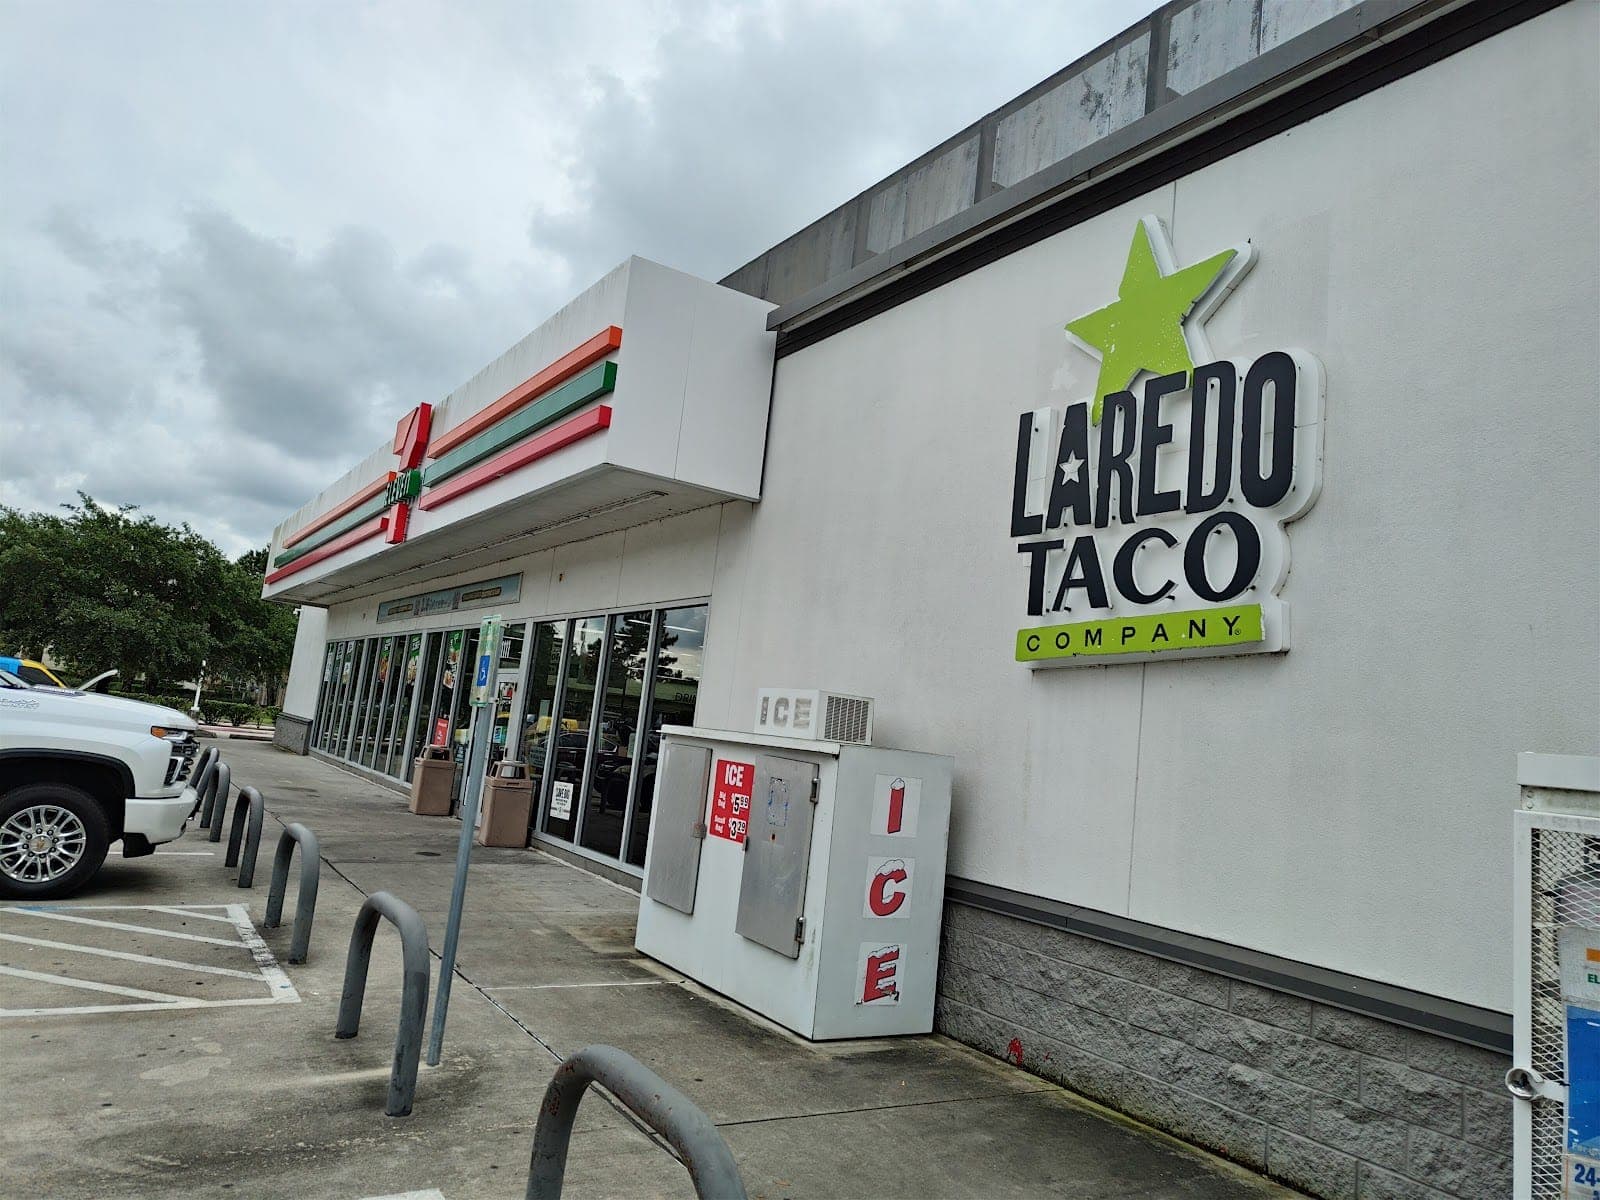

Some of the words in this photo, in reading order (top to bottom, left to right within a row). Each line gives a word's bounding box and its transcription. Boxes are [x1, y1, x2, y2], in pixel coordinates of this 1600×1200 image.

[1010, 351, 1297, 537] LAREDO
[1017, 511, 1261, 616] TACO
[759, 696, 812, 729] ICE
[725, 764, 744, 787] ICE
